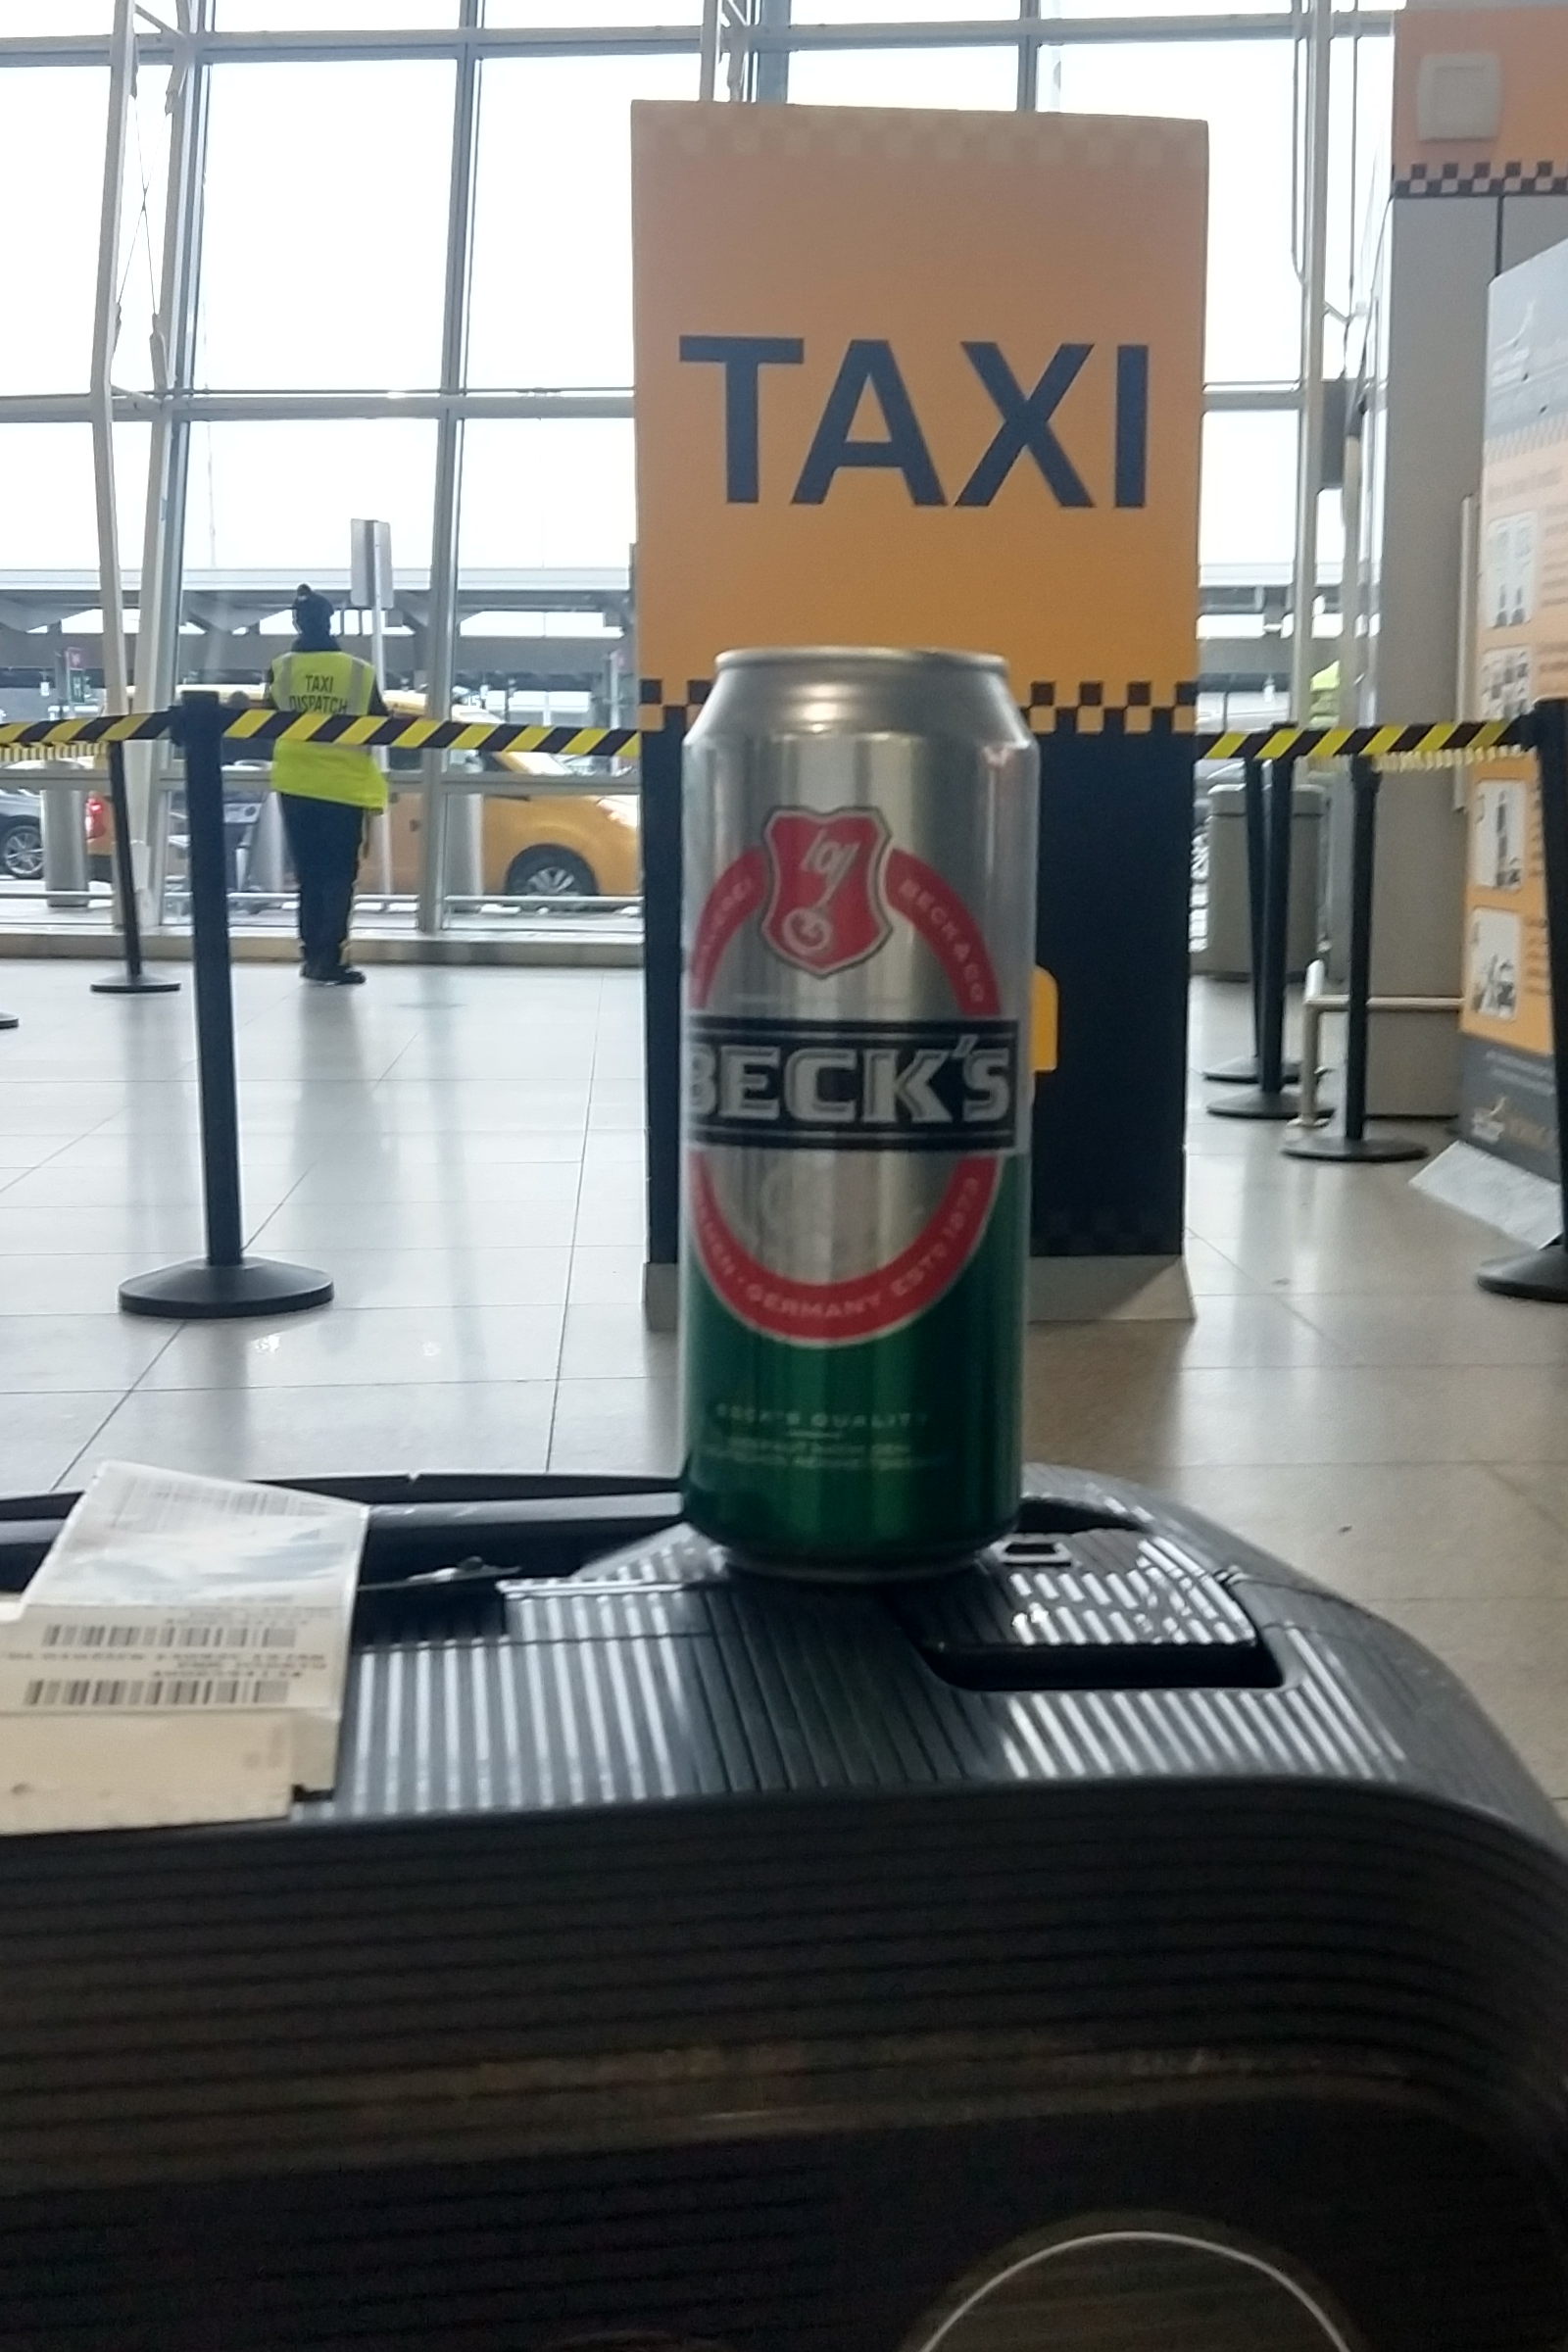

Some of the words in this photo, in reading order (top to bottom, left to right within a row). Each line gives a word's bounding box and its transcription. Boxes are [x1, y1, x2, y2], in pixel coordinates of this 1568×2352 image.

[679, 335, 1149, 509] TAXI
[289, 695, 349, 714] DISPATCH
[305, 674, 334, 694] TAXI
[688, 1034, 1010, 1124] BECK'S
